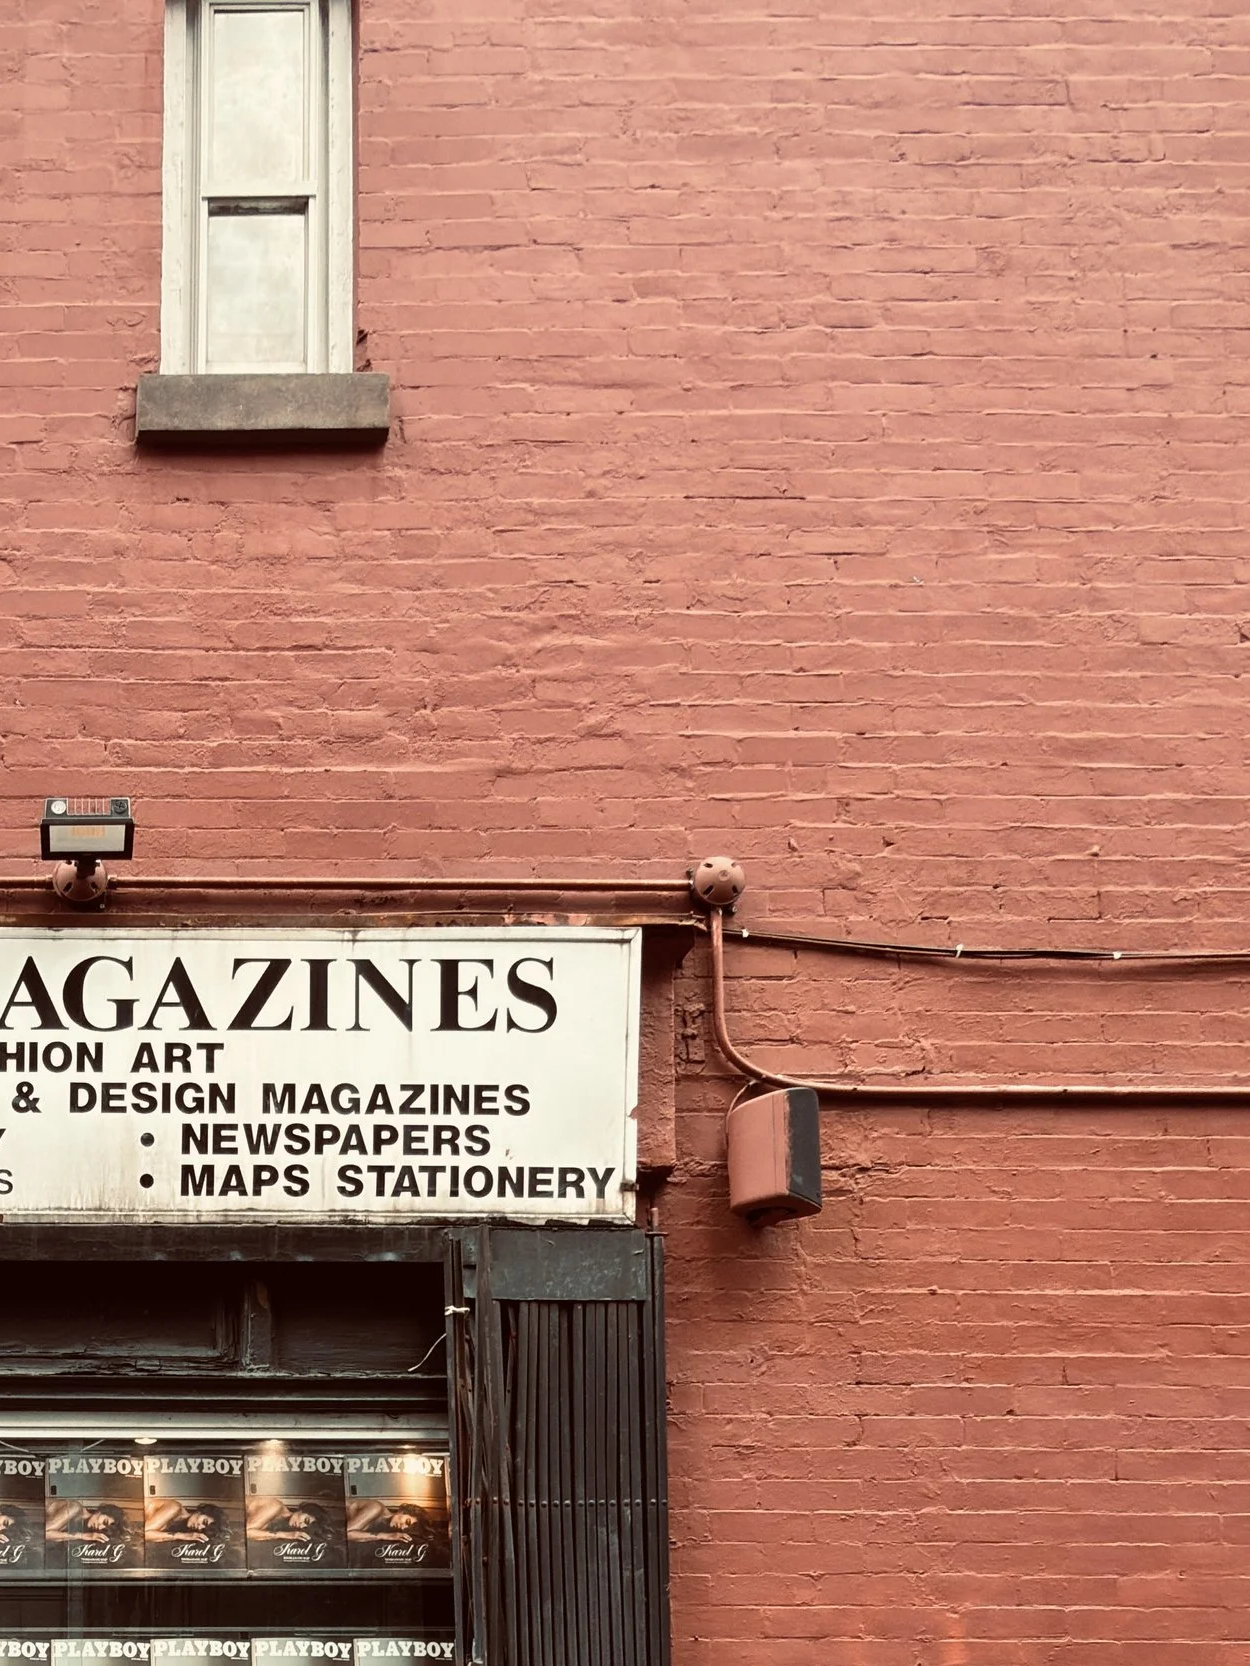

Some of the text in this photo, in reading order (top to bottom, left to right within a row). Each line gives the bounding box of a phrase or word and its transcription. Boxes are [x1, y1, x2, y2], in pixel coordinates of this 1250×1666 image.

[130, 1042, 225, 1074] ART
[11, 1080, 42, 1114] &
[69, 1082, 236, 1114] DESIGN
[263, 1083, 532, 1117] MAGAZINES
[180, 1123, 492, 1157] NEWSPAPERS
[180, 1164, 617, 1200] MAPS STATIONERY
[48, 1458, 144, 1476] PLAYBOY
[148, 1458, 243, 1476] PLAYBOY
[248, 1458, 343, 1476] PLAYBOY
[350, 1458, 443, 1476] PLAYBOY
[53, 1642, 150, 1659] PLAYBOY
[154, 1642, 250, 1659] PLAYBOY
[255, 1642, 352, 1659] PLAYBOY
[357, 1642, 455, 1659] PLAYBOY
